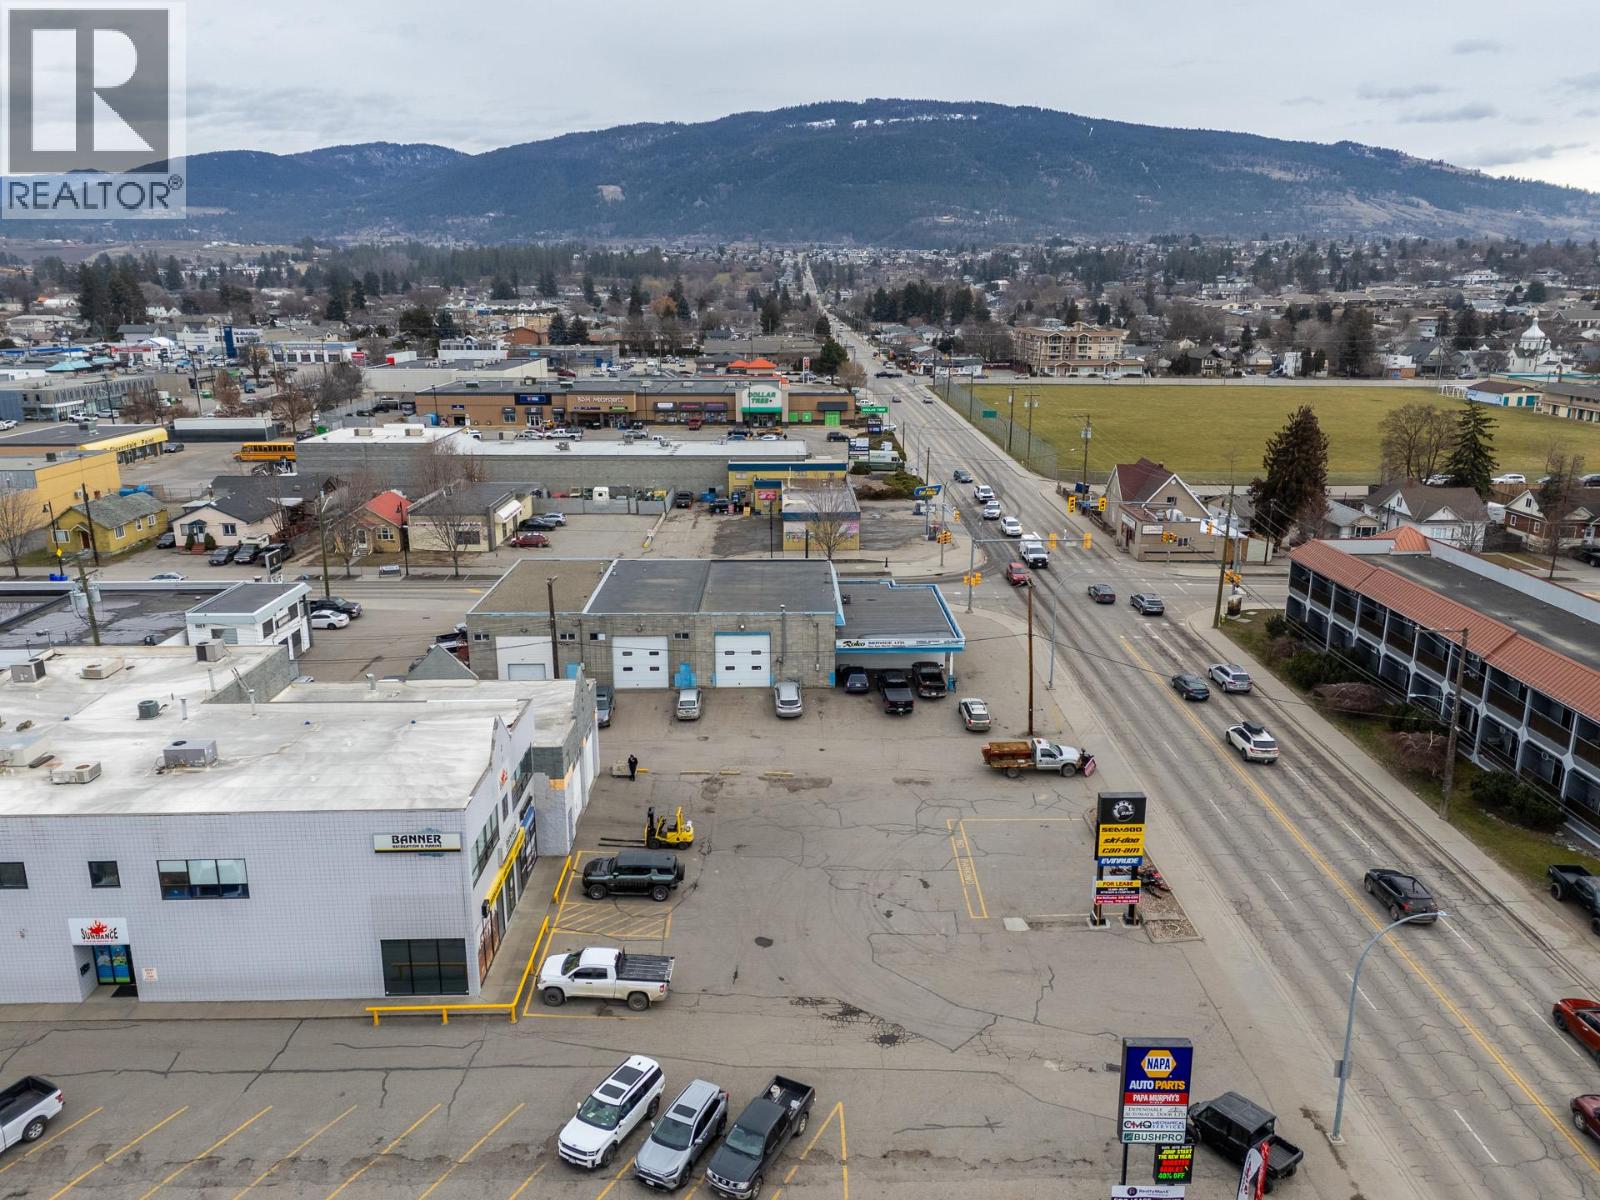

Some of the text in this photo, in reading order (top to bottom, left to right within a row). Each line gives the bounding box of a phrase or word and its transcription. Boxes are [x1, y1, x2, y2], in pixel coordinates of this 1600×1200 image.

[391, 834, 442, 844] BANNER
[80, 927, 119, 940] SUNDANCE
[1146, 1057, 1171, 1070] NAPA
[1130, 1080, 1186, 1090] AUTO PARTS
[1149, 1093, 1180, 1102] MURPHY'S
[1134, 1133, 1183, 1141] BUSHPRO
